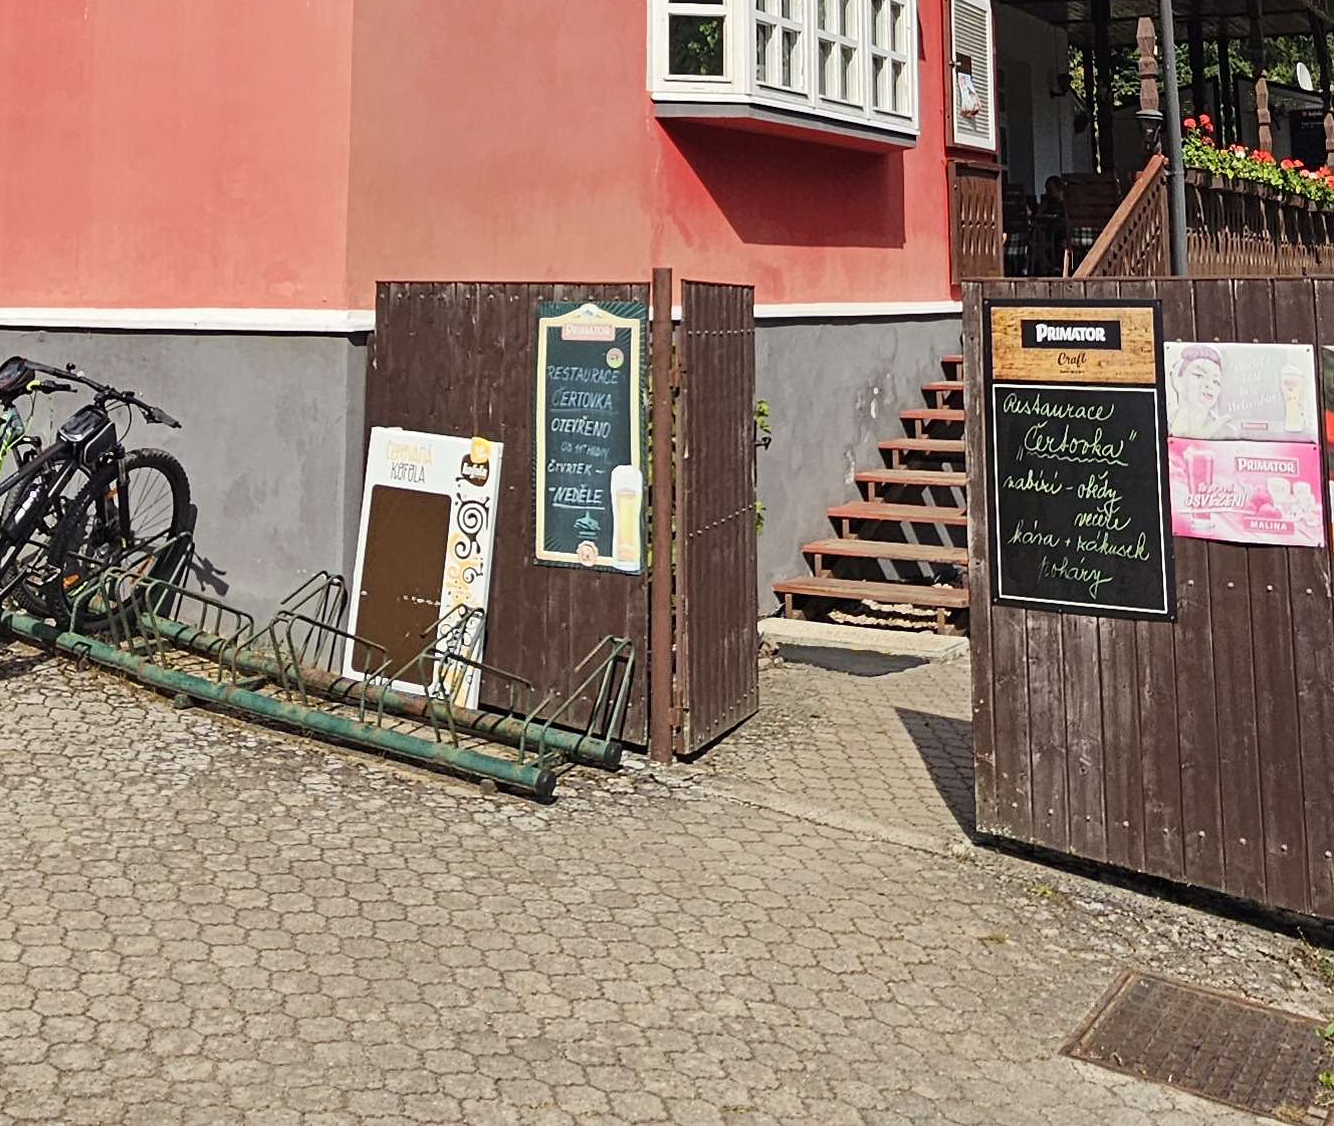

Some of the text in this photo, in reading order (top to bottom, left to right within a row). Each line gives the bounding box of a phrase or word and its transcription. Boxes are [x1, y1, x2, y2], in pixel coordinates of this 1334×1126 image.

[1035, 323, 1106, 343] PRIMATOR
[1057, 352, 1087, 368] Craft
[547, 365, 621, 385] RESTAURACE
[551, 385, 613, 410] ČERTOVKA
[1003, 393, 1115, 421] Restaurace
[551, 415, 612, 438] OTEVŘENO
[461, 462, 489, 480] kofola
[547, 459, 593, 476] ČTVRTEK
[1237, 458, 1296, 473] PRIMATOR
[1250, 520, 1287, 531] MALINA
[1037, 556, 1113, 600] poháry
